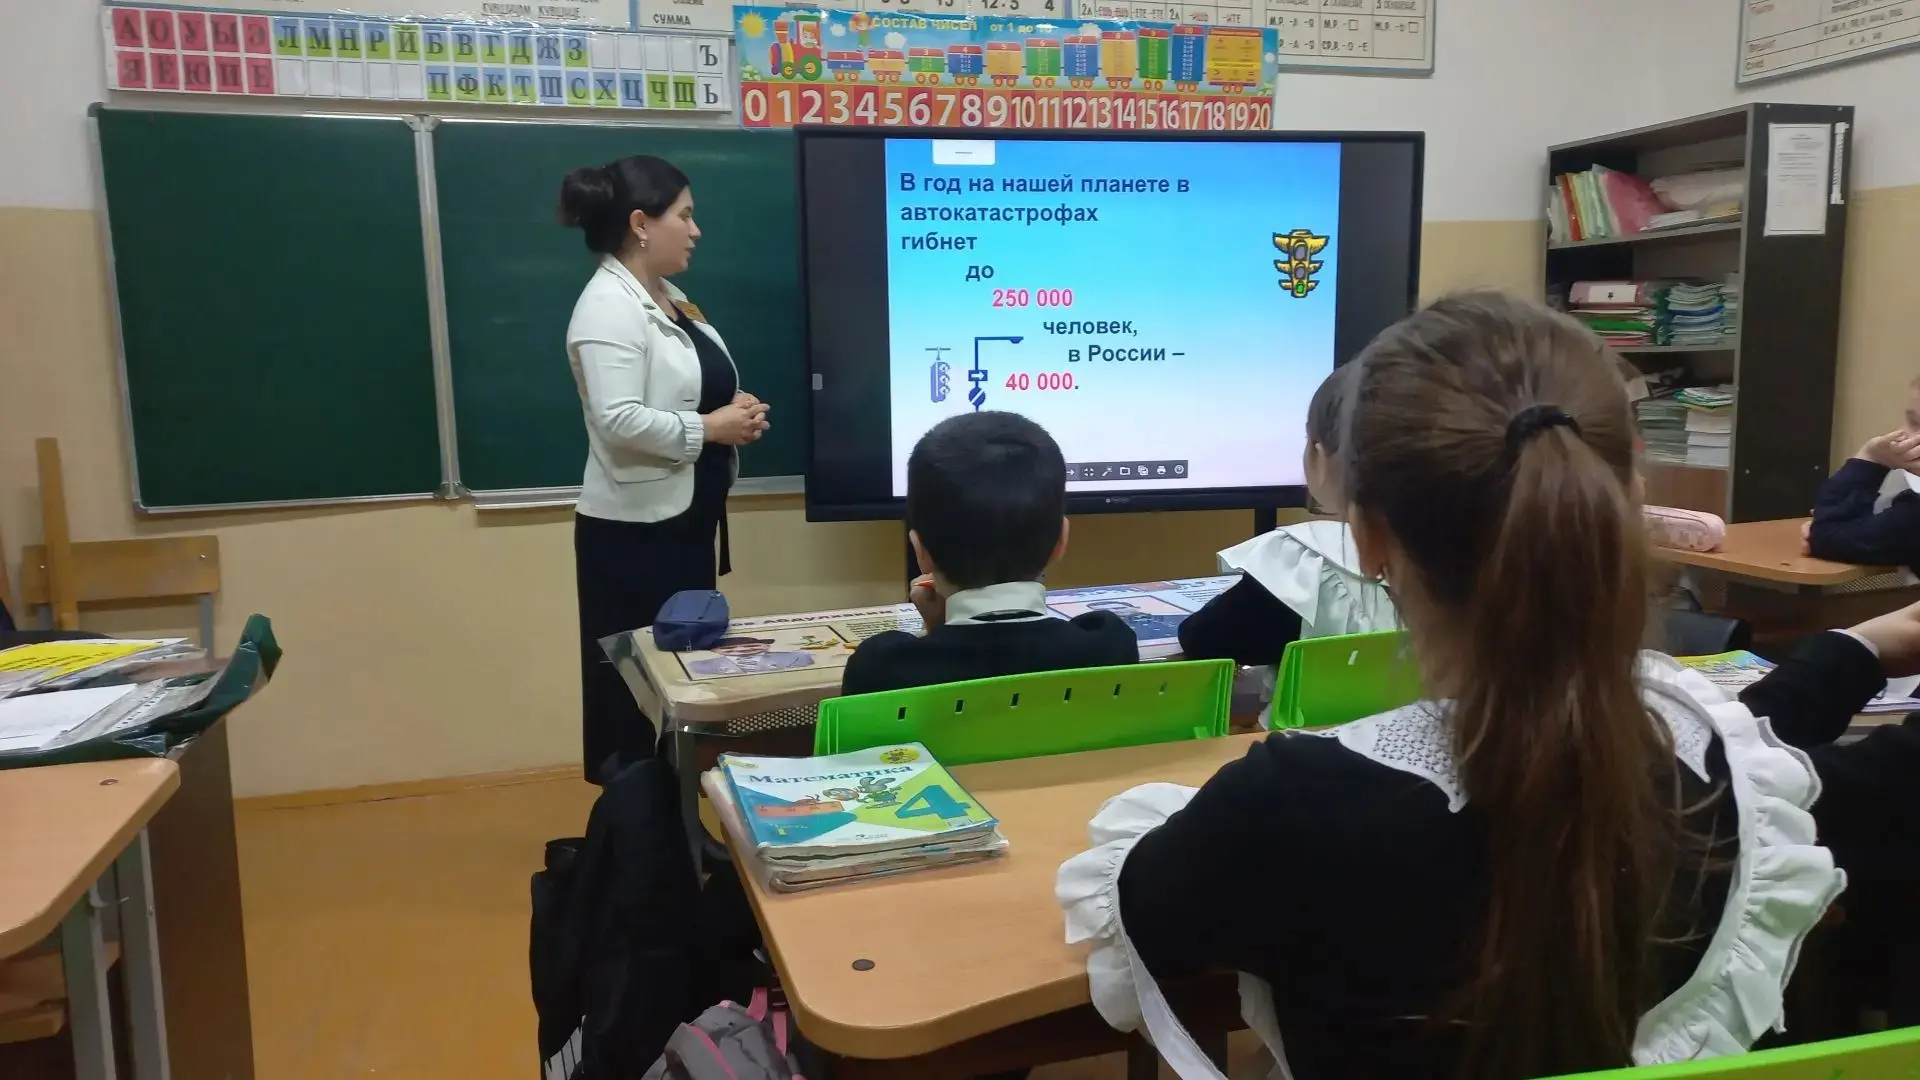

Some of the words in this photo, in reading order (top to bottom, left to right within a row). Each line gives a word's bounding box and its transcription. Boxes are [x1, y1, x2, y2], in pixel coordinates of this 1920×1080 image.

[653, 13, 691, 26] СУММА
[872, 15, 928, 29] СОСТАВ
[931, 19, 978, 31] ЧИСЕЛ
[744, 89, 767, 122] 0
[776, 90, 792, 123] 1
[802, 90, 823, 123] 2
[830, 91, 849, 123] 3
[855, 92, 878, 124] 4
[884, 93, 903, 124] 5
[909, 93, 931, 125] 6
[936, 95, 956, 126] 7
[961, 94, 983, 127] 8
[987, 96, 1008, 127] 9
[1011, 96, 1036, 128] 10
[1038, 97, 1060, 128] 11
[1063, 97, 1087, 128] 12
[1088, 97, 1112, 129] 13
[1113, 98, 1137, 129] 14
[1137, 99, 1158, 129] 15
[1159, 100, 1180, 129] 16
[1180, 101, 1202, 129] 17
[1204, 101, 1225, 130] 18
[1226, 102, 1249, 130] 19
[1251, 102, 1271, 130] 20
[900, 173, 916, 192] В
[924, 177, 961, 196] год
[969, 178, 995, 193] на
[1002, 172, 1073, 193] нашей
[1081, 177, 1170, 194] планете
[1177, 178, 1190, 193] в
[900, 204, 1099, 226] автокатастрофах
[901, 231, 978, 251] гибнет
[966, 263, 995, 282] до
[992, 289, 1029, 308] 250
[1036, 289, 1074, 308] 000
[1043, 318, 1138, 338] человек,
[1068, 347, 1081, 362] в
[1088, 344, 1166, 362] России
[1005, 372, 1030, 391] 40
[1037, 372, 1079, 391] 000.
[748, 764, 914, 785] Математика
[894, 784, 973, 820] 4
